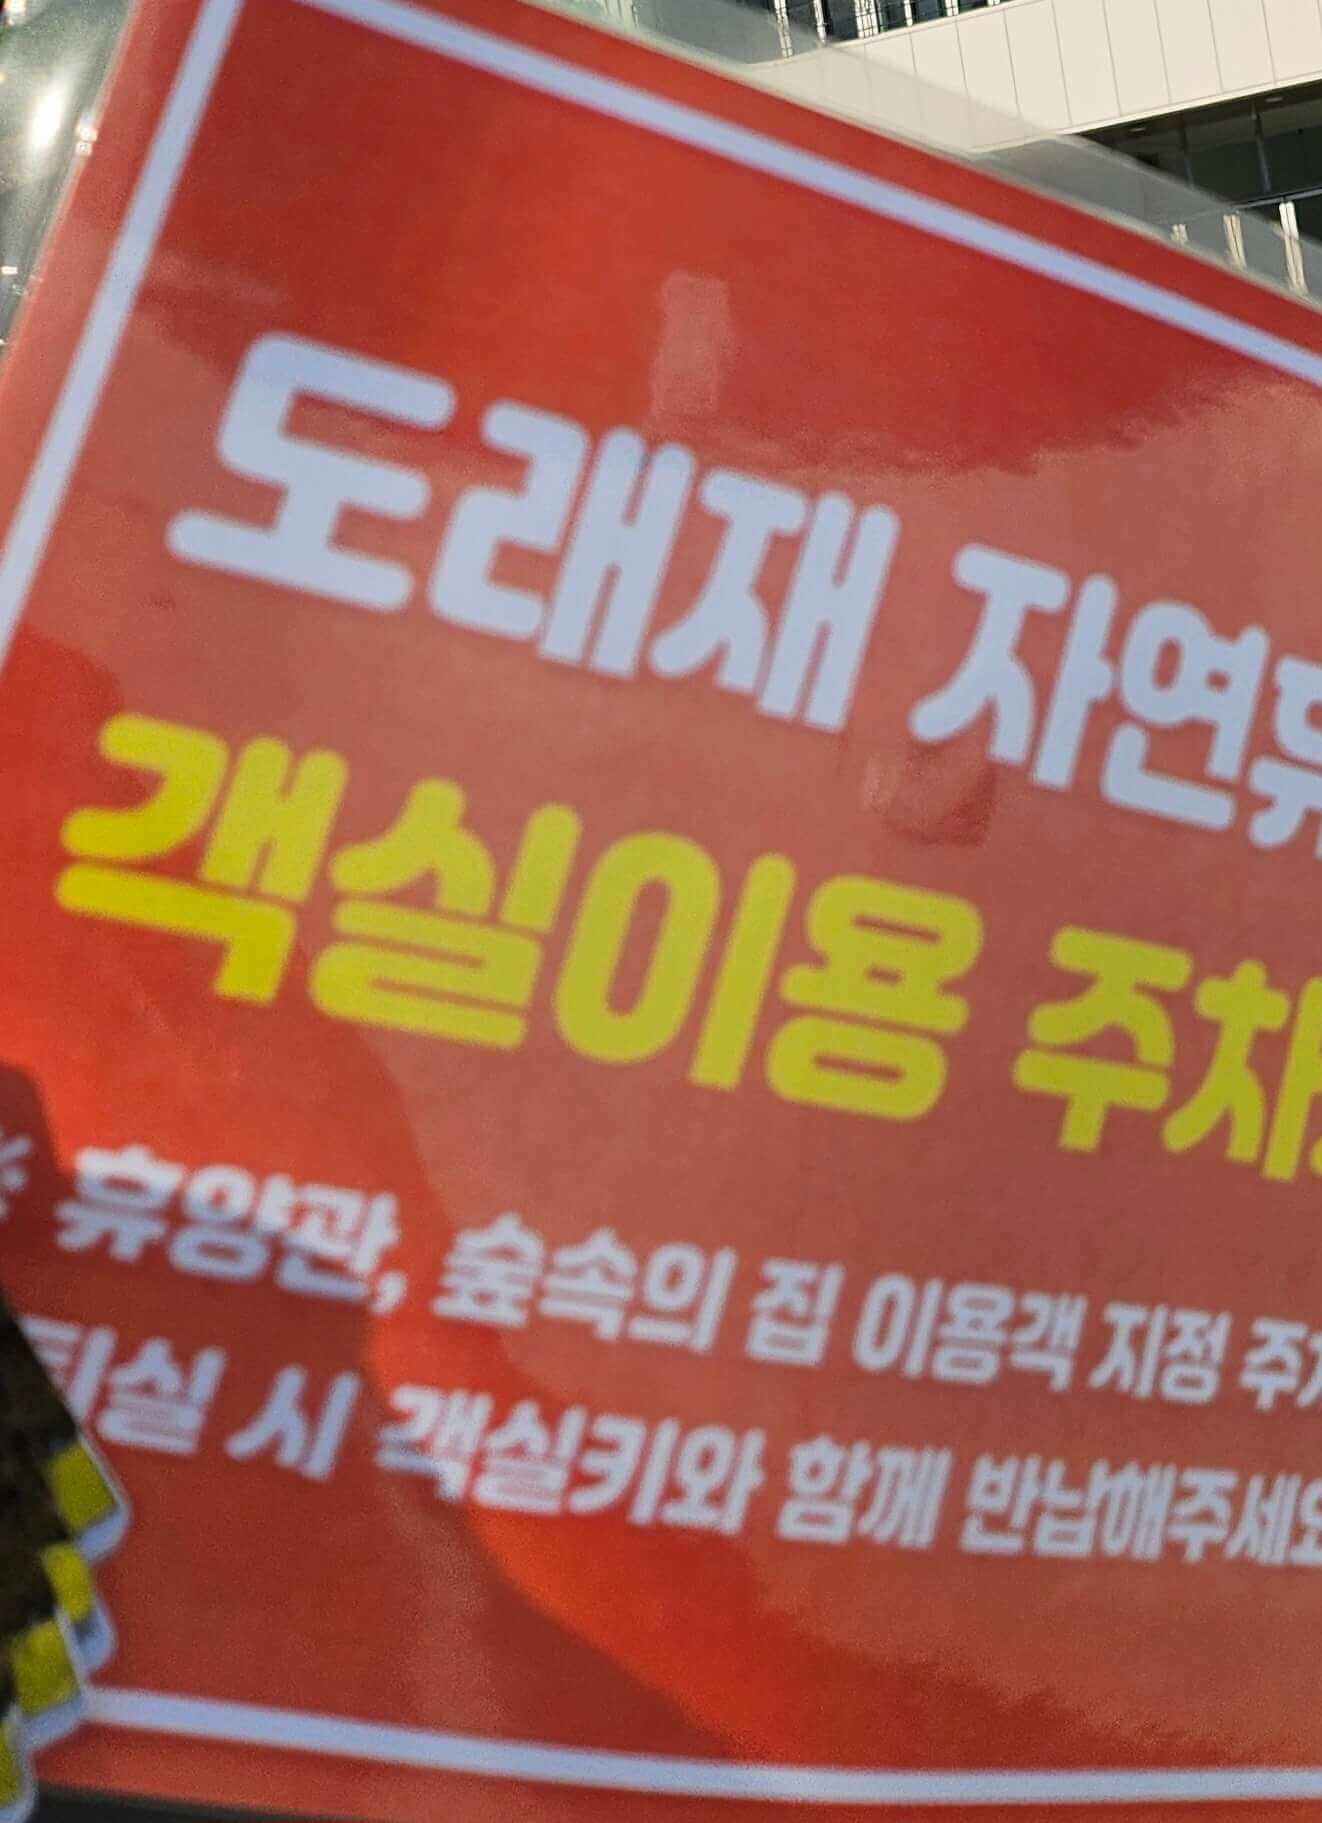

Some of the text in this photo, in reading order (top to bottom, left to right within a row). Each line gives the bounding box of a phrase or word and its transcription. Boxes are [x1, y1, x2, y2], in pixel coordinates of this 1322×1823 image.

[167, 331, 903, 733] 도래재
[58, 714, 984, 1121] 객실이용
[56, 1146, 406, 1314] 휴양관,
[434, 1212, 737, 1352] 숲속의
[746, 1259, 845, 1366] 집
[852, 1273, 1088, 1392] 이용객
[1089, 1302, 1233, 1404] 지정
[228, 1366, 361, 1479] 시
[377, 1385, 765, 1534] 객실키와
[778, 1435, 953, 1548] 함께
